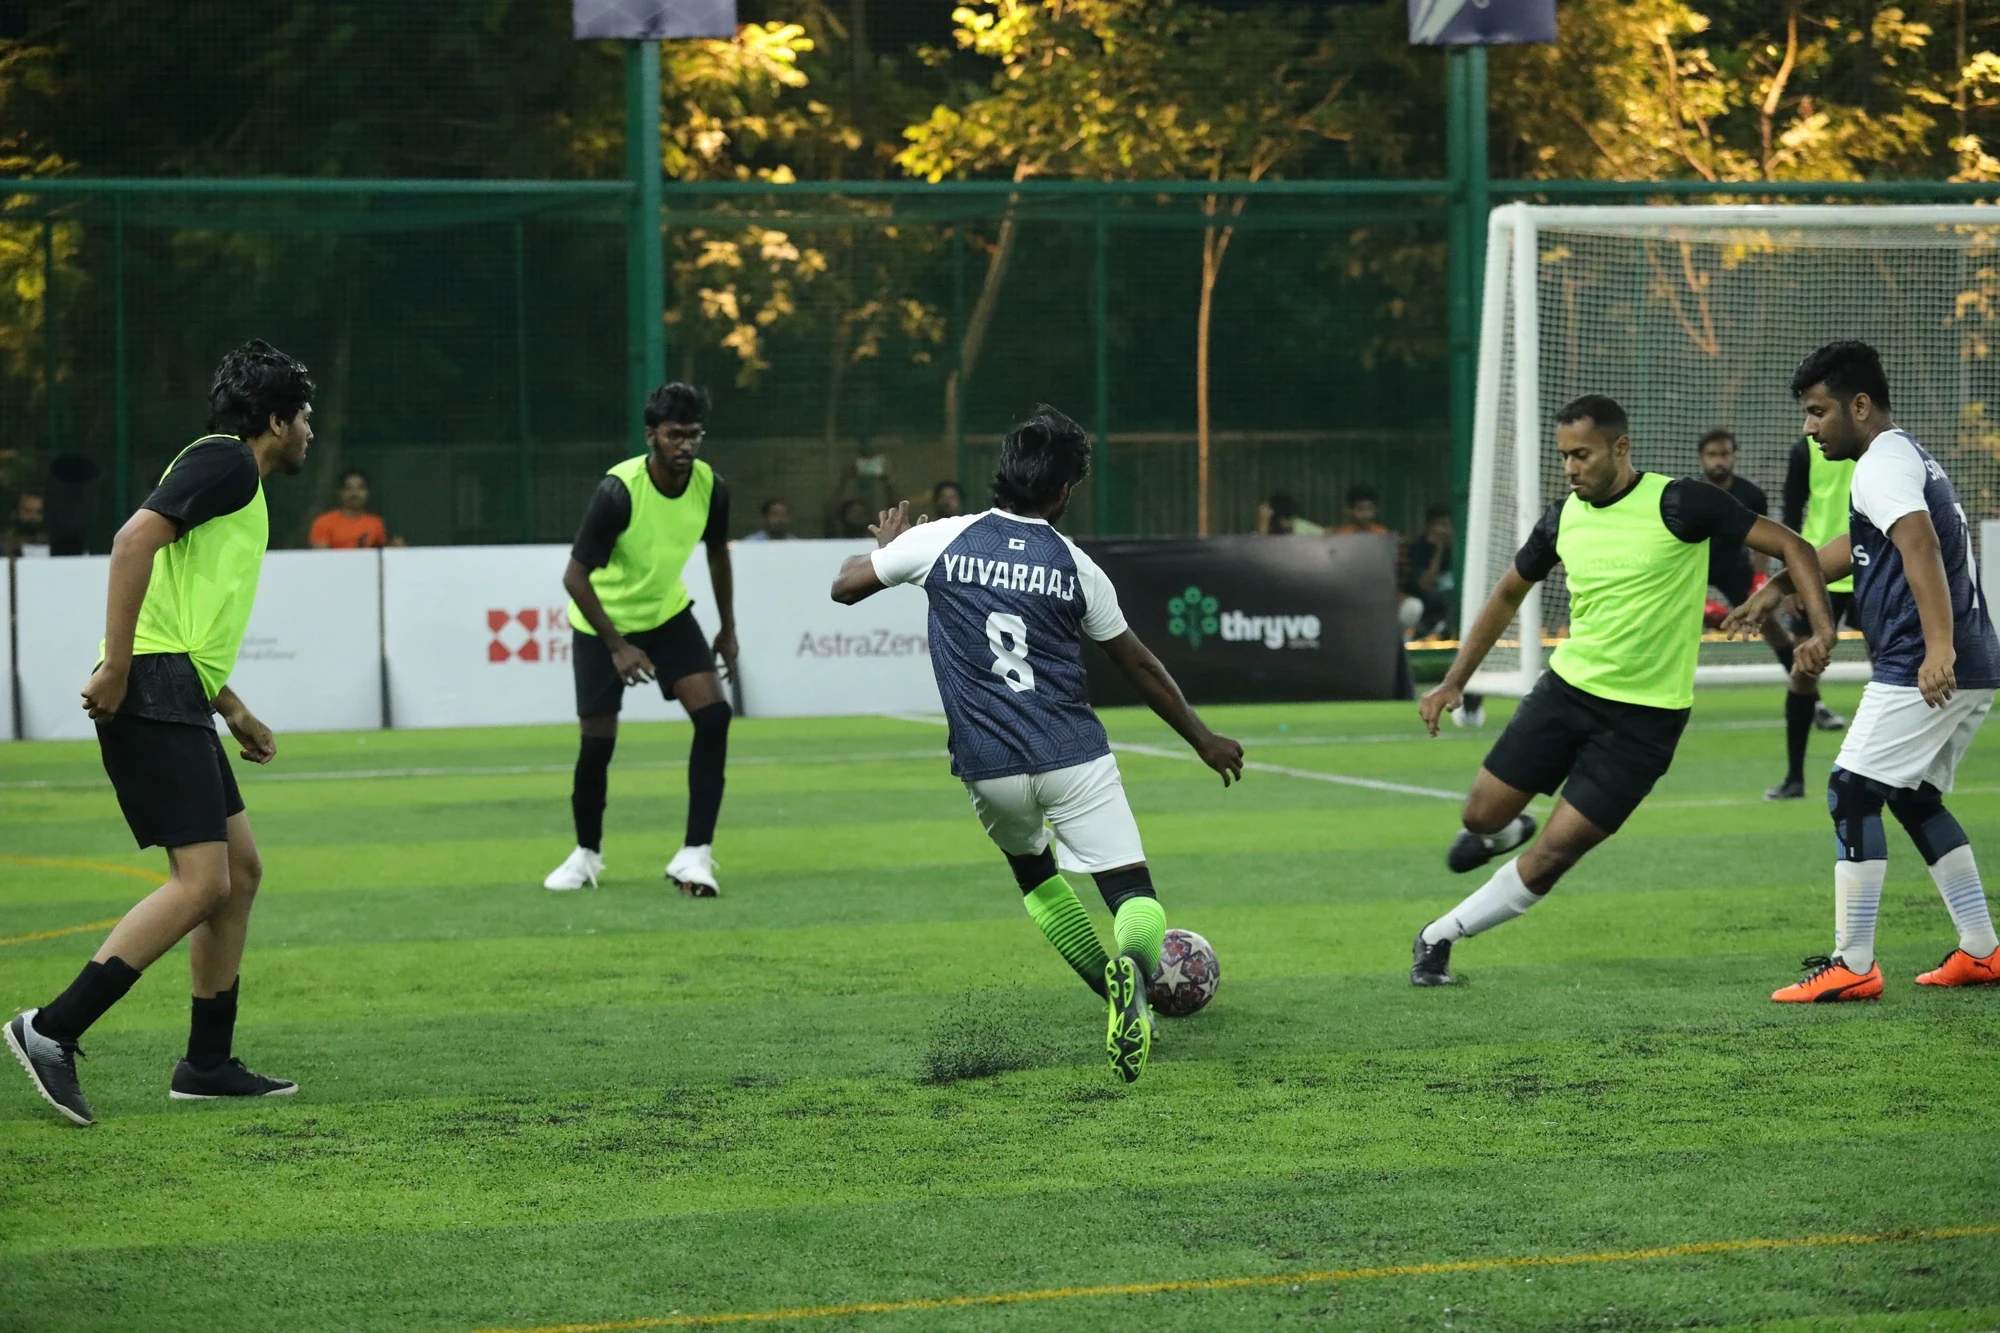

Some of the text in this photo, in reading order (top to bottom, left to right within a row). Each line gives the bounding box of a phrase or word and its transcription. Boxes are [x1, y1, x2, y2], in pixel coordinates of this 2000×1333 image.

[944, 553, 1076, 602] YUVARAAJ
[985, 611, 1036, 693] 8
[1220, 609, 1321, 650] thryve
